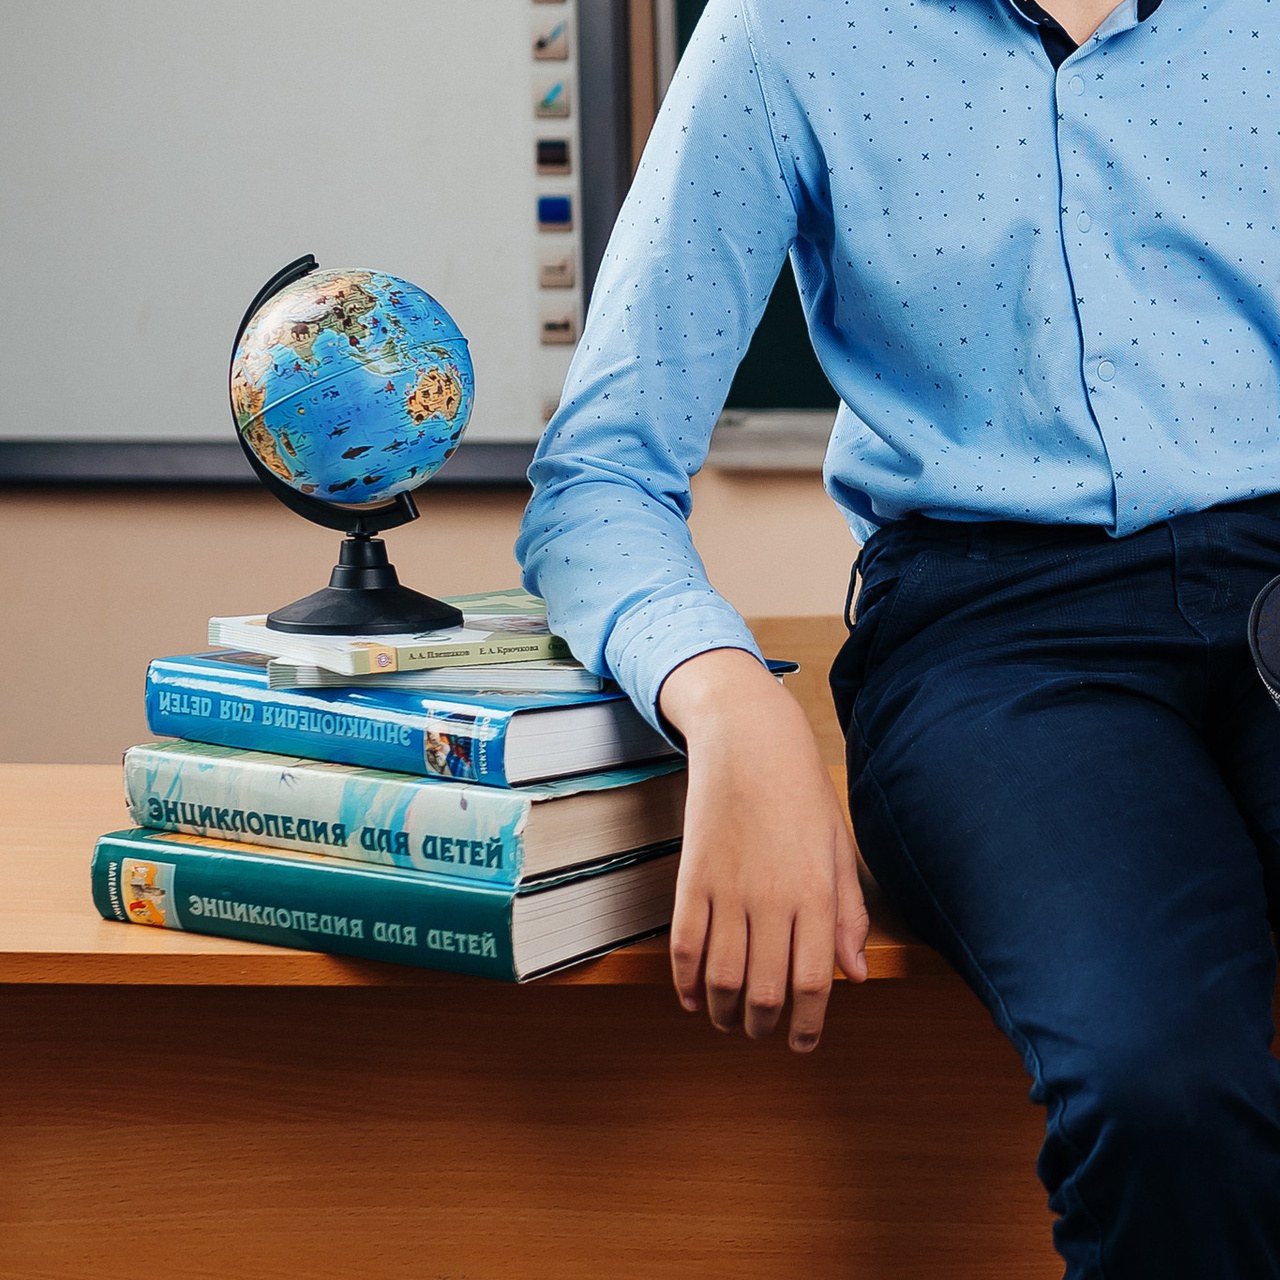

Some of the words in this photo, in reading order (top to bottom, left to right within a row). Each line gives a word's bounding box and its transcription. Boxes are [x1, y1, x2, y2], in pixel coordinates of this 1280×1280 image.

[158, 690, 213, 718] ДЕТЕЙ
[219, 700, 256, 724] ДЛЯ
[261, 704, 412, 747] ЭНЦИКЛОПЕДИЯ
[147, 797, 348, 848] ЭНЦИКЛОПЕДИЯ
[360, 826, 411, 856] ДЛЯ
[422, 835, 503, 869] ДЕТЕЙ
[188, 894, 365, 939] ЭНЦИКЛОПЕДИЯ
[372, 921, 418, 947] ДЛЯ
[427, 928, 499, 959] ДЕТЕЙ
